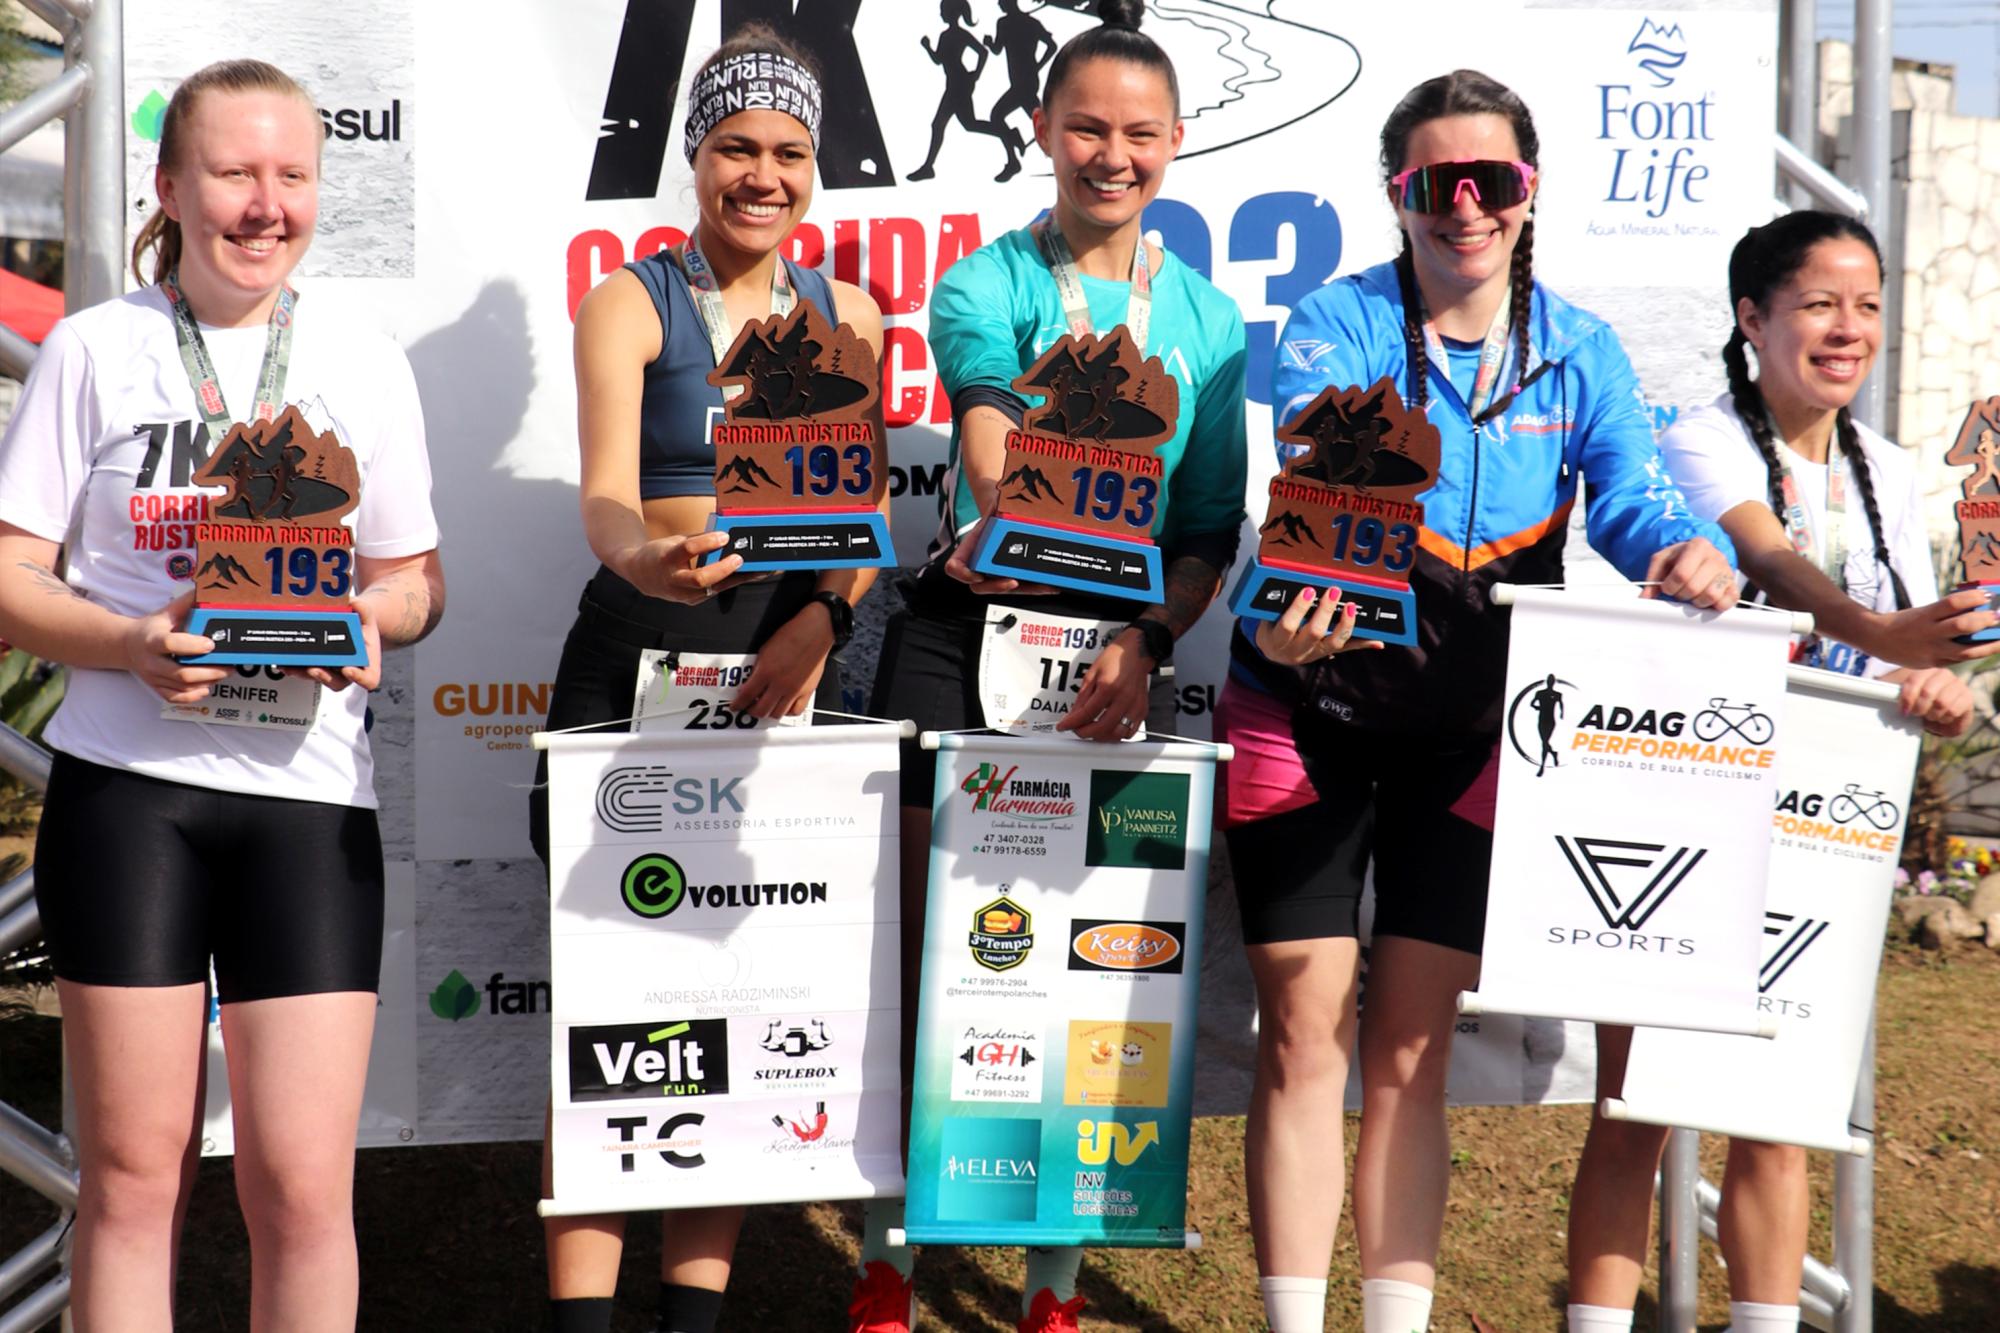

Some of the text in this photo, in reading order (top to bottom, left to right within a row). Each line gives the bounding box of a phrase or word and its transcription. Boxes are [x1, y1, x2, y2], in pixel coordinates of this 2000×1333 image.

[1596, 84, 1715, 140] Font
[1603, 147, 1709, 218] Life
[715, 420, 873, 444] CORRIDA RÚSTICA
[1009, 432, 1163, 477] CORRIDA RÚSTICA
[784, 445, 872, 496] 193
[1072, 466, 1158, 529] 193
[1271, 480, 1347, 511] CORRIDA
[197, 521, 354, 545] CORRIDA RÚSTICA
[1332, 513, 1418, 572] 193
[265, 547, 350, 597] 193
[1063, 627, 1098, 649] 193
[211, 684, 278, 703] JENIFER
[215, 708, 240, 718] ASSIS
[1577, 704, 1687, 738] ADAG
[487, 741, 522, 751] Centro
[1571, 733, 1776, 769] PERFORMANCE
[1581, 757, 1634, 769] CORRIDA
[1640, 763, 1656, 772] DE
[1661, 765, 1685, 774] RUA
[1703, 769, 1763, 782] CICLISMO
[672, 777, 744, 815] SK
[961, 764, 1077, 815] Harmonia
[1010, 779, 1071, 799] FARMÁCIA
[674, 816, 856, 831] ASSESSORIA ESPORTIVA
[1126, 809, 1176, 821] VANUSA
[980, 846, 1047, 856] 47 99178-6559
[984, 834, 1045, 845] 47 3407-0328
[1090, 933, 1167, 958] Keisy
[1547, 927, 1696, 956] SPORTS
[983, 953, 1017, 963] Lanches
[644, 989, 718, 1004] ANDRESSA
[964, 1026, 1036, 1041] Academia
[754, 1067, 838, 1080] SUPLEBOX
[975, 1069, 1026, 1082] Fitness
[967, 1158, 1036, 1178] ELEVA
[1075, 1171, 1106, 1188] INV
